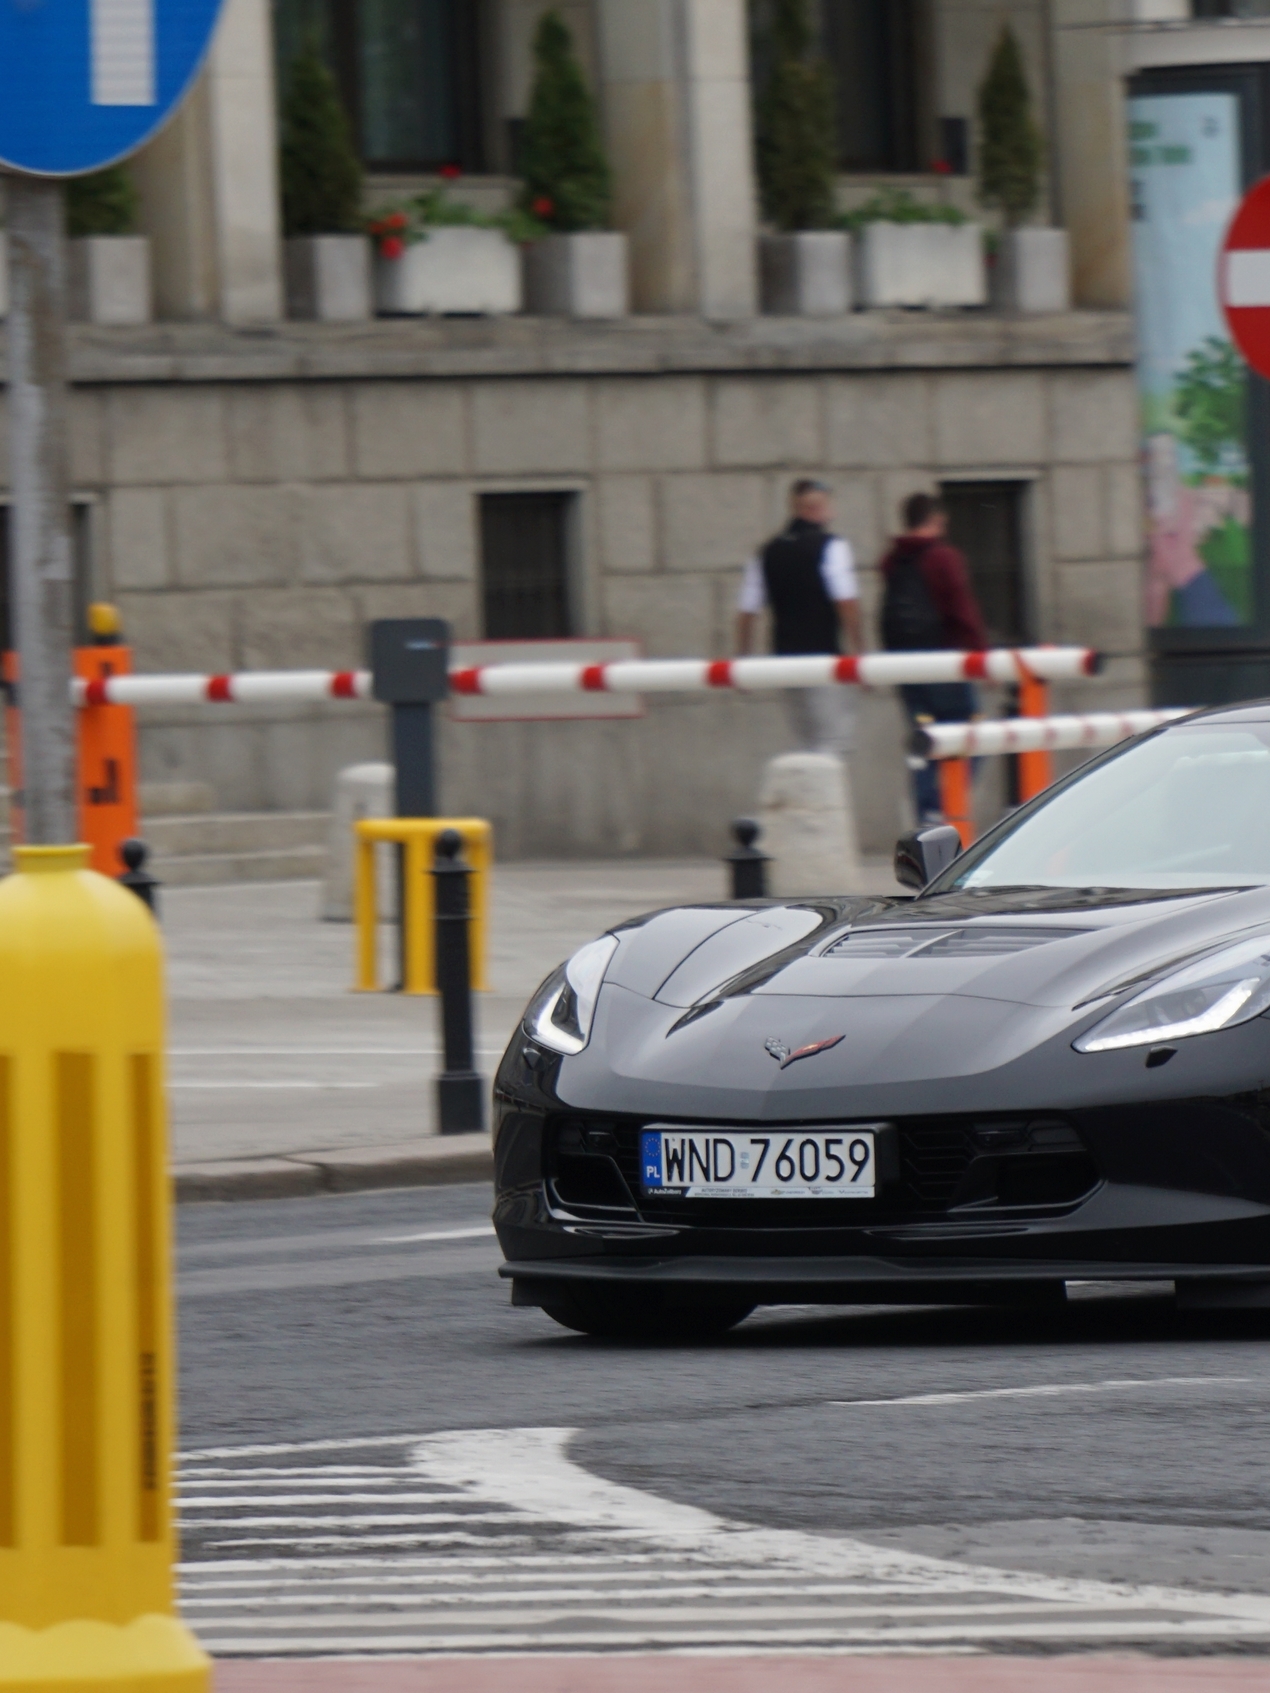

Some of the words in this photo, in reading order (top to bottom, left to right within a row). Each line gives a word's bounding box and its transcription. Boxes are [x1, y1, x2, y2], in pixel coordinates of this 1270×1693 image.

[646, 1165, 660, 1179] PL
[664, 1138, 736, 1183] WND
[750, 1138, 871, 1183] 76059
